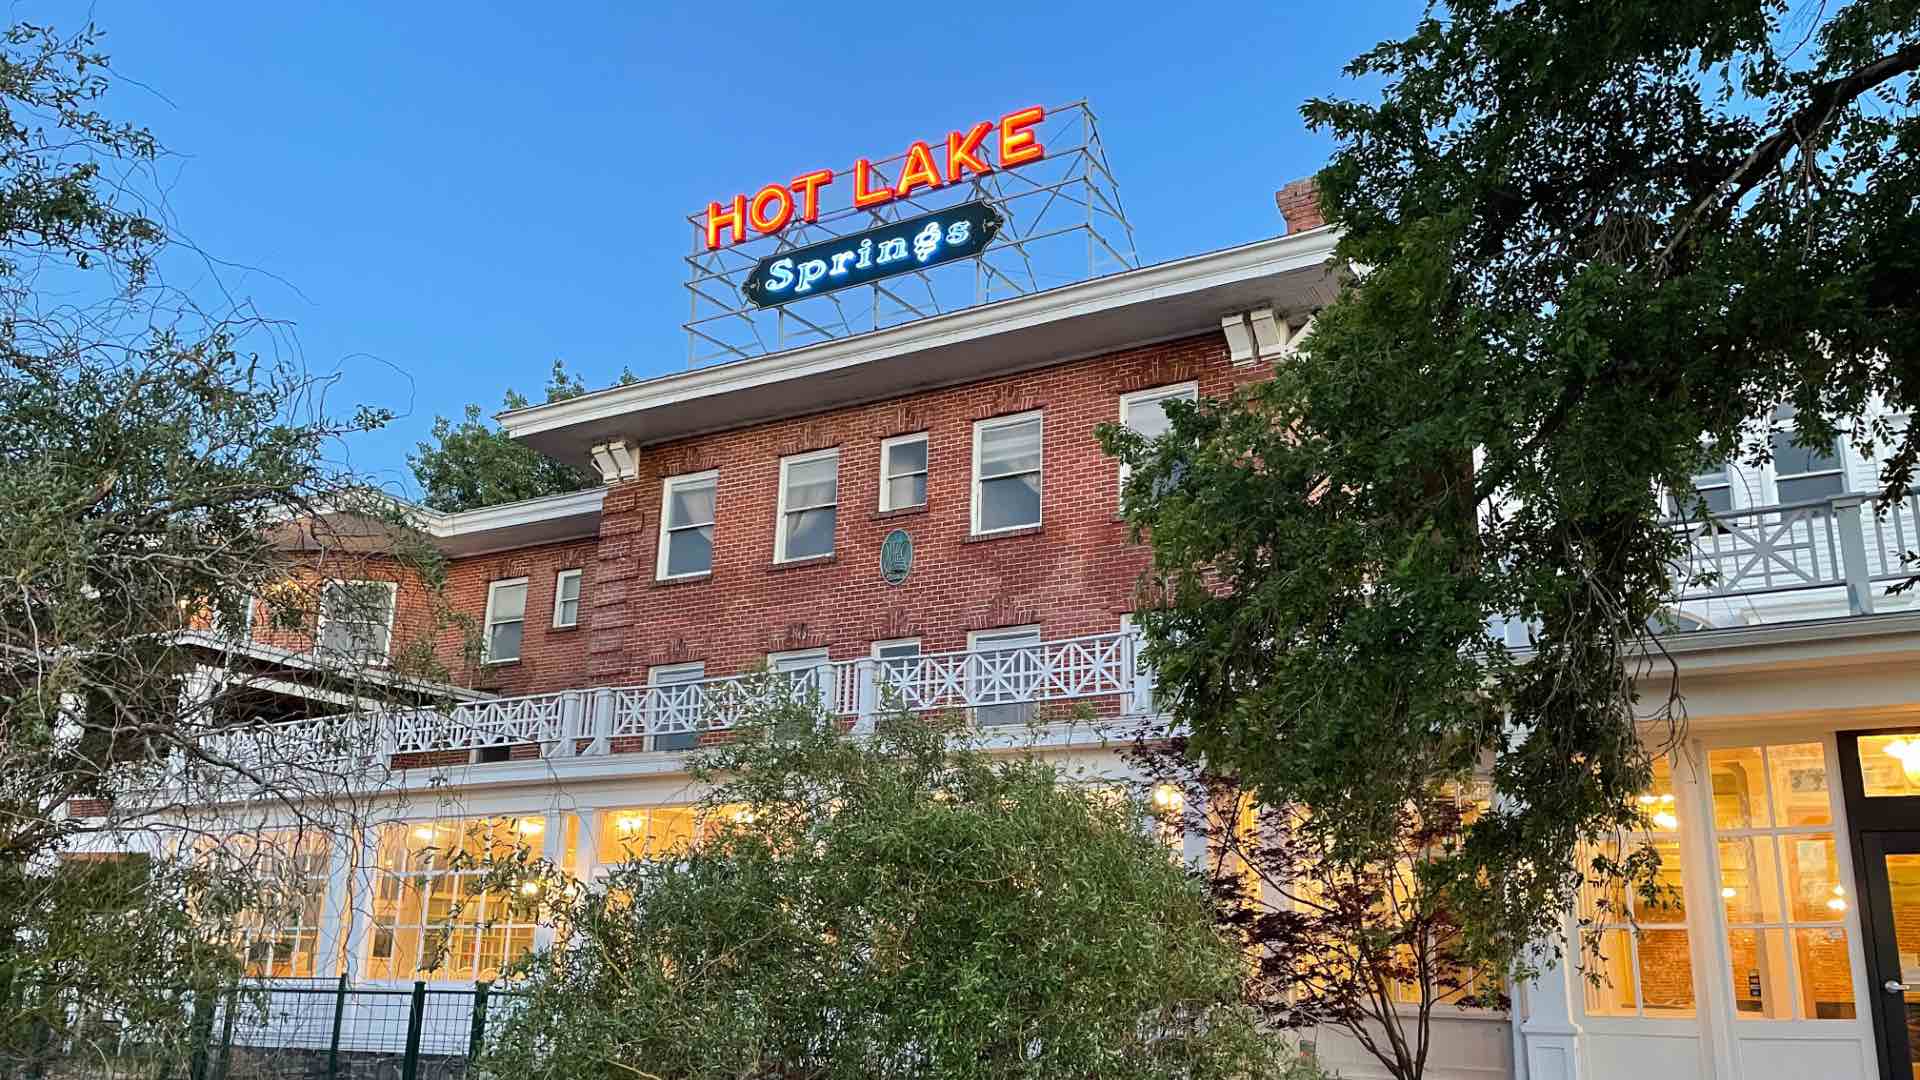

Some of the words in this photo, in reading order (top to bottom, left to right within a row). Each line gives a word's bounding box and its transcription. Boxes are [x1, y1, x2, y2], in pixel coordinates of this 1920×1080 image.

[705, 169, 833, 250] HOT
[853, 105, 1044, 209] LAKE
[764, 221, 971, 292] Springs
